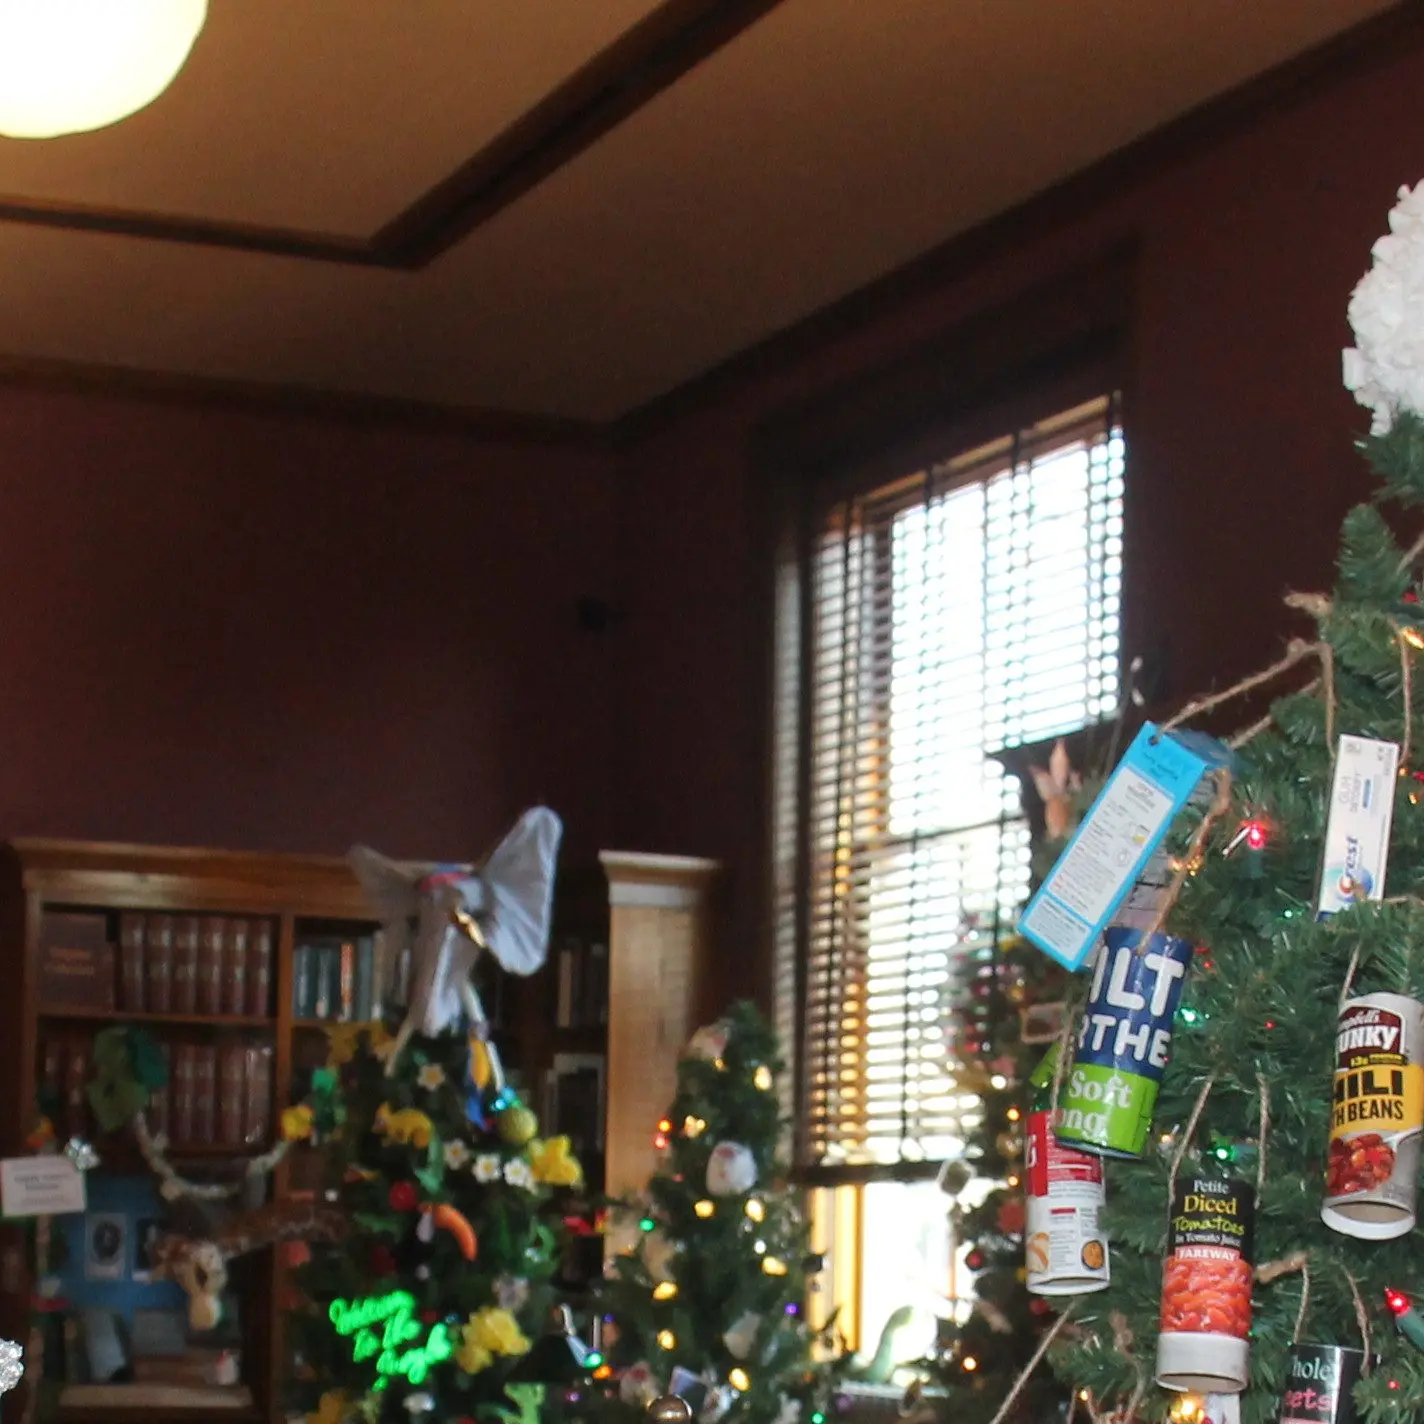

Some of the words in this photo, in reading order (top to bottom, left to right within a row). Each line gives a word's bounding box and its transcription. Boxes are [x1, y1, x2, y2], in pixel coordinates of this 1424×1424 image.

[1068, 1069, 1133, 1109] Soft
[1347, 1099, 1405, 1123] BEANS
[1193, 1179, 1231, 1195] Petite
[1183, 1194, 1238, 1216] Diced
[1173, 1215, 1245, 1236] Tomatoes
